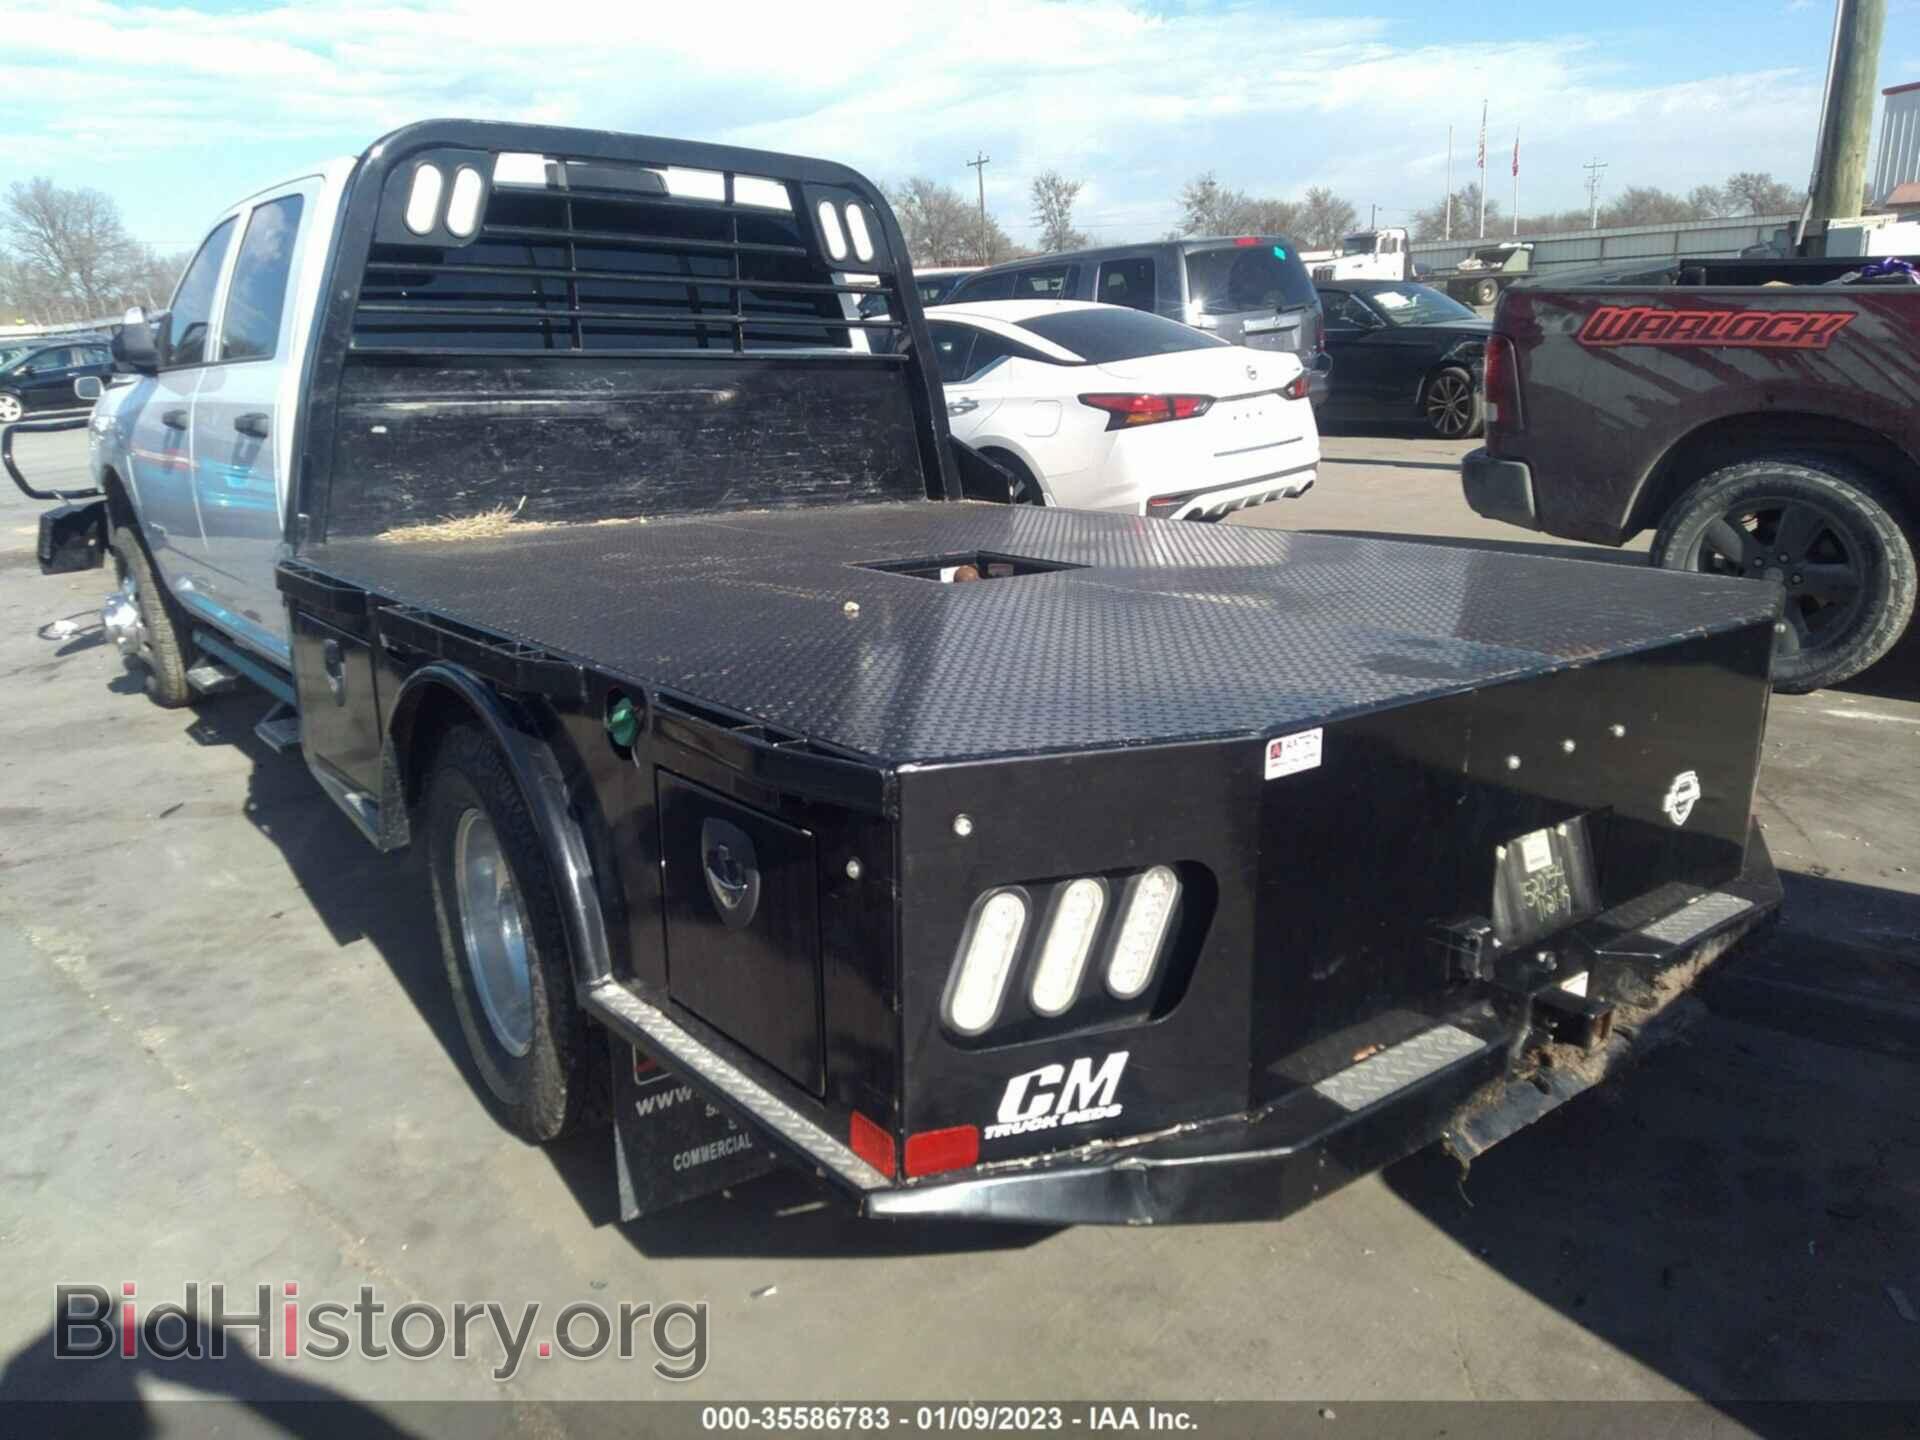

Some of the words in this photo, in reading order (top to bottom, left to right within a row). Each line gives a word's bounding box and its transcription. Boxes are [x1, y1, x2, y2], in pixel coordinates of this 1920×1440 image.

[997, 1050, 1130, 1123] CM
[984, 1114, 1060, 1140] TRUCK
[1061, 1103, 1123, 1126] BEDS
[673, 1132, 753, 1171] COMMERCIAL
